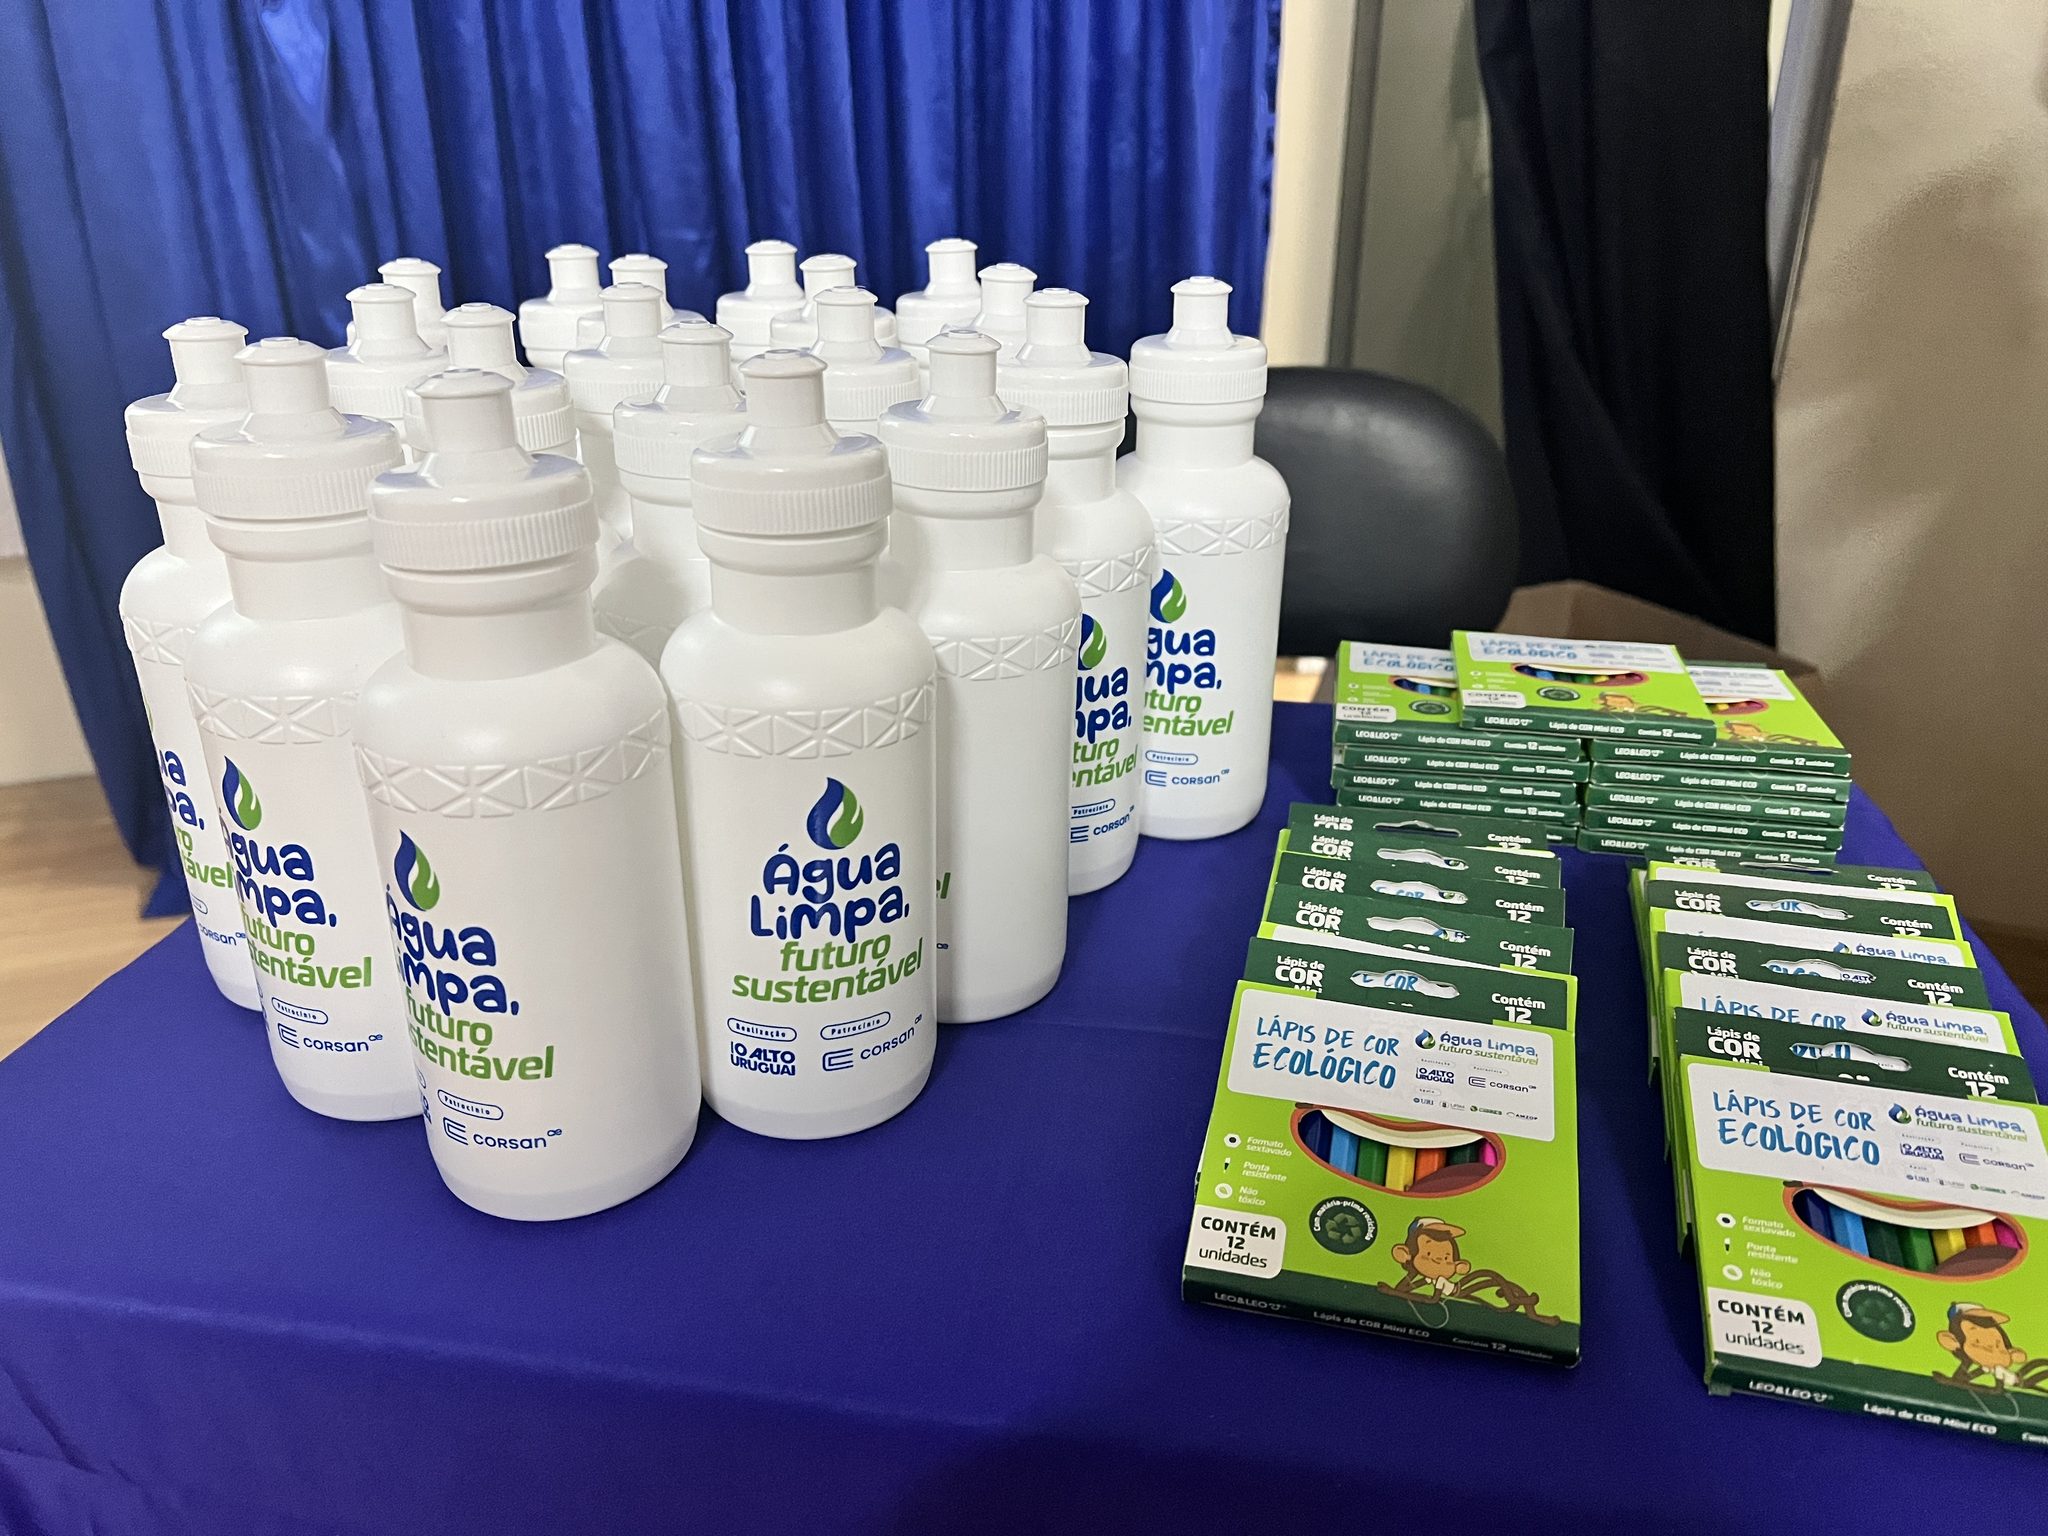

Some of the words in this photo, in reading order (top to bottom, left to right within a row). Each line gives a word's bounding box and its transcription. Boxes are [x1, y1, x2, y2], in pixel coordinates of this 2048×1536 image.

[1147, 627, 1216, 660] gua
[1146, 660, 1222, 695] mpa,
[1144, 689, 1202, 713] turo
[1143, 710, 1234, 737] entável
[1073, 738, 1119, 763] turo
[1072, 744, 1138, 787] ntável
[1311, 842, 1352, 858] COR
[763, 843, 900, 904] Água
[1303, 866, 1331, 877] Lápis
[1333, 871, 1347, 880] de
[1494, 866, 1540, 879] Contém
[1867, 874, 1917, 885] Contém
[1301, 874, 1345, 893] COR
[236, 870, 336, 928] mpa,
[1298, 900, 1327, 912] Lápis
[1329, 907, 1344, 915] de
[1495, 899, 1544, 912] Contém
[1675, 896, 1721, 912] COR
[750, 886, 909, 943] Limpa,
[1296, 909, 1341, 930] COR
[1507, 909, 1531, 923] 12
[1880, 916, 1933, 929] Contém
[386, 884, 496, 967] Água
[780, 934, 891, 972] futuro
[1500, 940, 1551, 957] Contém
[1687, 947, 1718, 958] Lápis
[1720, 951, 1736, 960] de
[1856, 943, 1896, 956] Água
[1900, 949, 1950, 964] Limpa,
[250, 943, 371, 988] tentável
[732, 937, 923, 1004] sustentável
[1277, 955, 1308, 967] Lápis
[1310, 961, 1325, 970] de
[1511, 953, 1537, 969] 12
[1688, 955, 1736, 974] COR
[1275, 965, 1323, 987] COR
[1907, 979, 1964, 993] Contém
[1491, 993, 1545, 1009] Contém
[1923, 991, 1953, 1006] 12
[405, 986, 493, 1047] futuro
[1505, 1006, 1532, 1024] 12
[1770, 1006, 1800, 1023] DE
[1886, 1010, 1929, 1027] Água
[1934, 1018, 1987, 1035] Limpa,
[735, 1021, 787, 1038] Realização
[831, 1017, 881, 1036] Patrocínio
[1256, 1014, 1316, 1045] LÁPIS
[1324, 1026, 1356, 1049] DE
[1364, 1034, 1399, 1058] COR
[1706, 1026, 1741, 1039] Lápis
[1743, 1032, 1761, 1042] de
[1886, 1021, 1921, 1033] futuro
[1923, 1027, 1989, 1044] sustentável
[409, 1023, 554, 1081] stentável
[1440, 1030, 1482, 1048] Água
[1487, 1039, 1538, 1057] Limpa,
[1708, 1036, 1762, 1059] COR
[750, 1048, 795, 1065] ALTO
[1439, 1043, 1472, 1055] futuro
[1474, 1049, 1538, 1066] sustentável
[730, 1055, 796, 1076] URUGUAI
[1253, 1042, 1397, 1090] ECOLÓGICO
[1429, 1068, 1454, 1078] ALTO
[1948, 1067, 2009, 1085] Contém
[1965, 1081, 1998, 1099] 12
[444, 1094, 490, 1116] Patrocínio
[1712, 1089, 1781, 1118] LÁPIS
[1790, 1102, 1821, 1123] DE
[1835, 1109, 1876, 1131] COR
[1915, 1105, 1962, 1123] Água
[1967, 1114, 2025, 1133] Limpa,
[1916, 1118, 1954, 1131] futuro
[1956, 1124, 2028, 1143] sustentável
[1246, 1144, 1292, 1156] sextavado
[1247, 1136, 1283, 1148] Formato
[1718, 1118, 1880, 1166] ECOLÓGICO
[1914, 1145, 1943, 1155] ALTO
[1242, 1169, 1287, 1182] resistente
[1243, 1161, 1270, 1172] Ponta
[1240, 1186, 1258, 1195] Não
[1238, 1196, 1266, 1206] tóxico
[1201, 1217, 1276, 1240] CONTÉM
[1742, 1216, 1783, 1229] Formato
[1743, 1224, 1796, 1237] sextavado
[1227, 1236, 1246, 1250] 12
[1747, 1242, 1776, 1253] Ponta
[1199, 1247, 1268, 1268] unidades
[1747, 1250, 1798, 1264] resistente
[1750, 1268, 1771, 1278] Não
[1752, 1277, 1783, 1289] tóxico
[1214, 1292, 1268, 1309] LEO&LEO
[1313, 1311, 1341, 1322] Lápis
[1344, 1316, 1357, 1324] de
[1359, 1319, 1381, 1328] COR
[1382, 1323, 1406, 1334] Mini
[1408, 1328, 1430, 1338] ECO
[1491, 1341, 1506, 1350] 12
[1718, 1299, 1805, 1325] CONTÉM
[1752, 1320, 1774, 1335] 12
[1726, 1332, 1805, 1355] unidades
[1749, 1380, 1811, 1399] LEO&LEO
[1864, 1403, 1895, 1416] Lápis
[1898, 1409, 1913, 1419] de
[1916, 1412, 1941, 1424] COR
[1943, 1417, 1970, 1430] Mini
[1972, 1423, 1997, 1435] ECO
